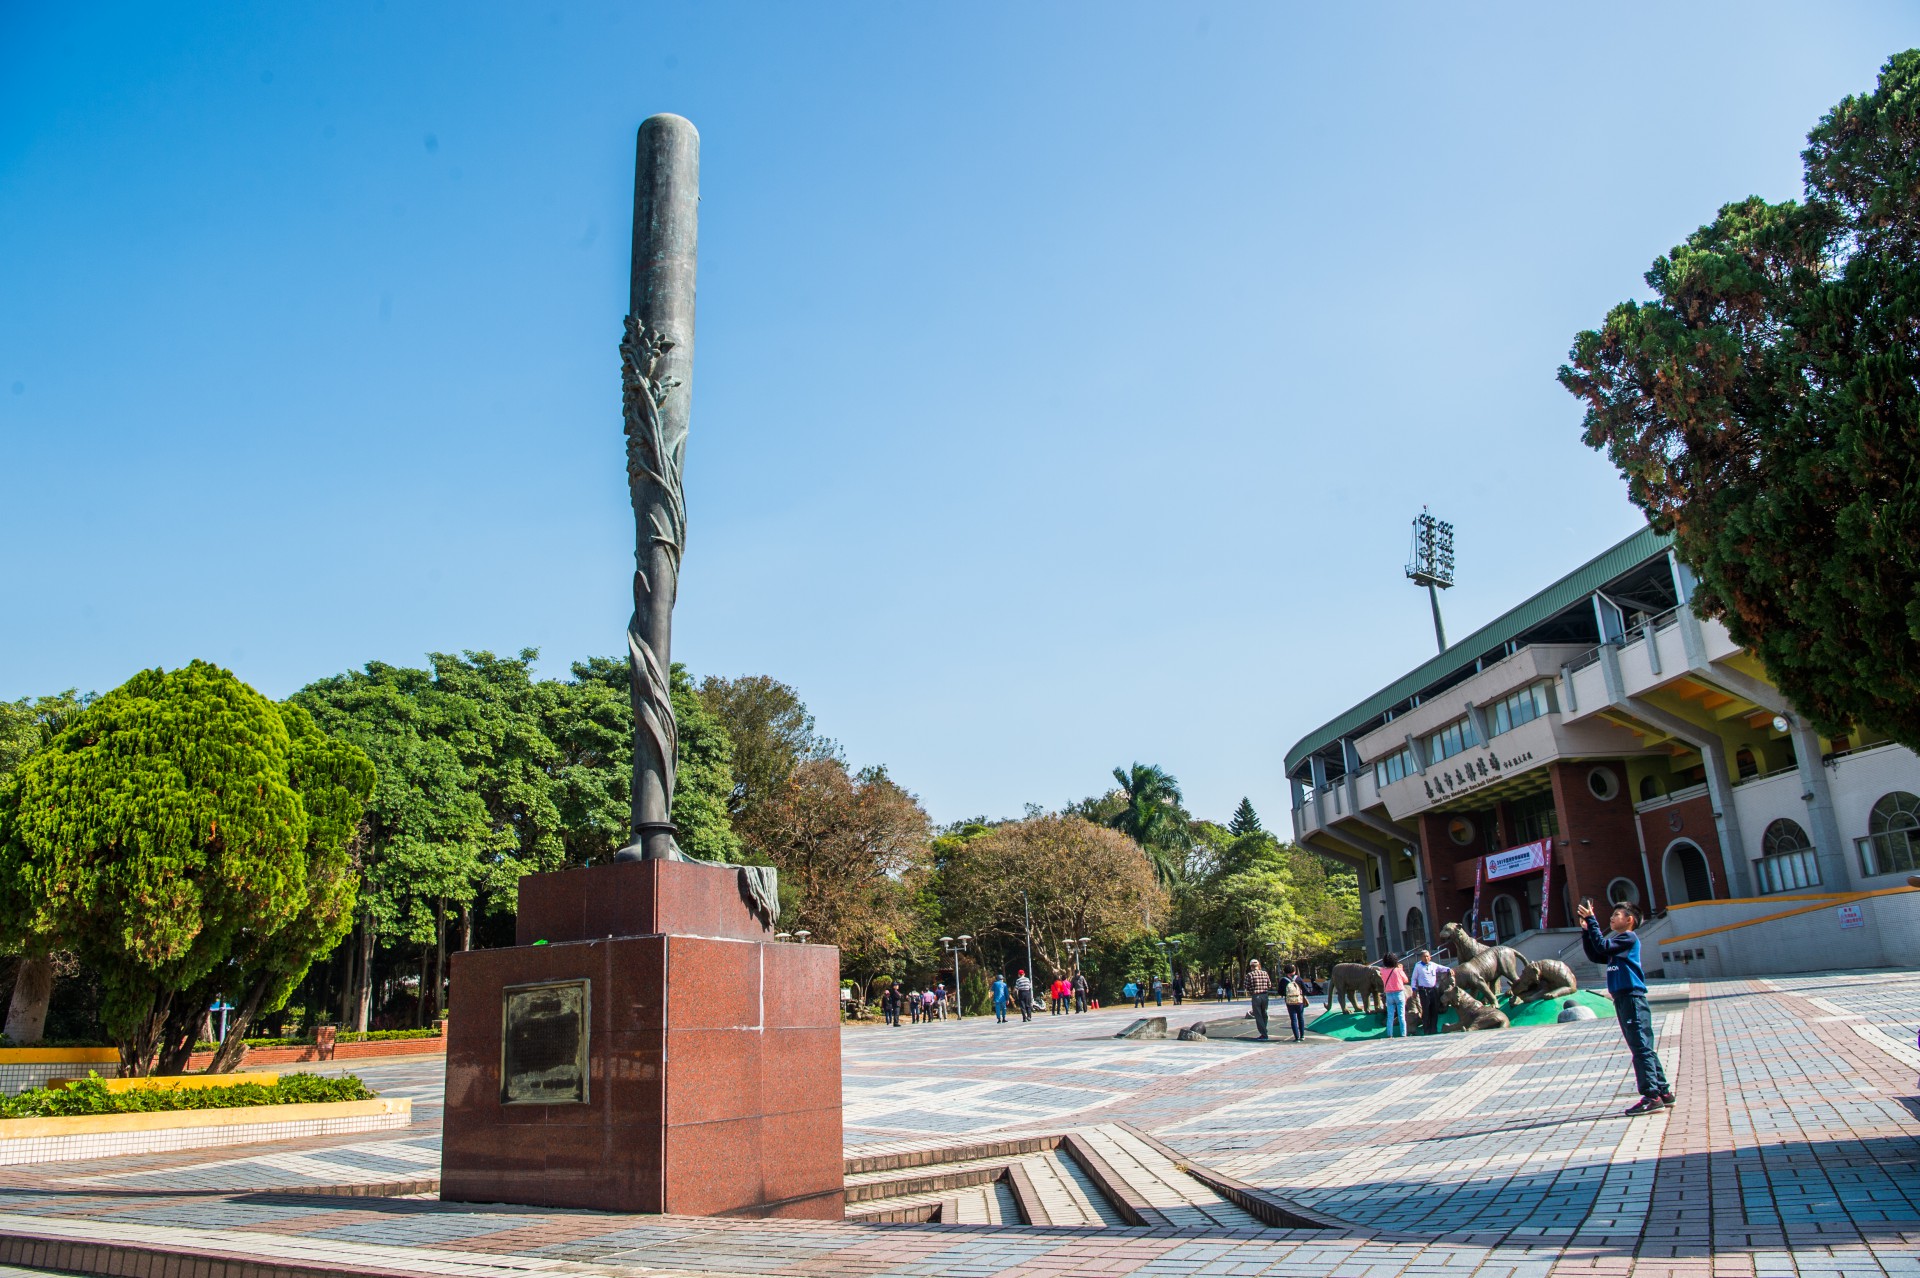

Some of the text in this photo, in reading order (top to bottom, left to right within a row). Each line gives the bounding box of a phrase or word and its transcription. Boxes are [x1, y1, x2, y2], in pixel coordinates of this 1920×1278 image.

[1424, 752, 1500, 799] 嘉義市立棒球場
[1667, 809, 1683, 832] 5
